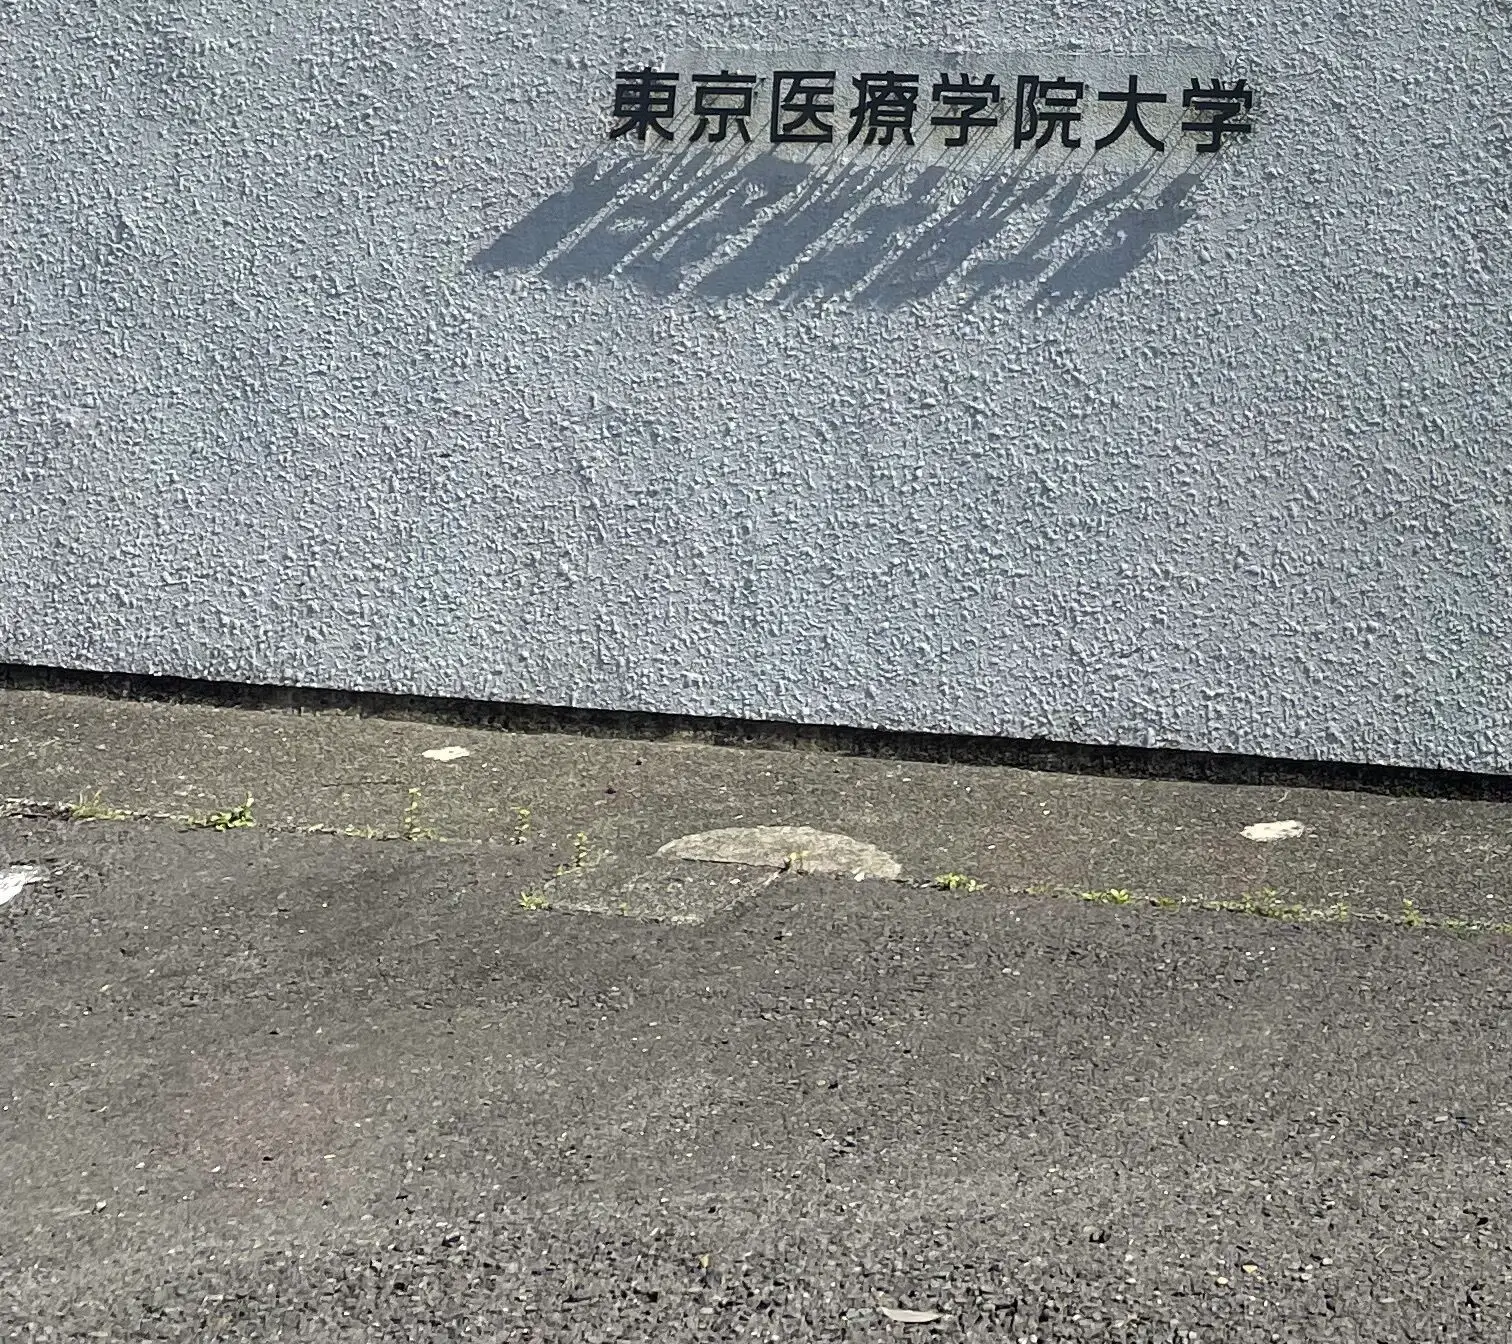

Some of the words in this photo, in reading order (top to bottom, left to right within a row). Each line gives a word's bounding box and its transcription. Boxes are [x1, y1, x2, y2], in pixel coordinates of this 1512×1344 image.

[608, 67, 1253, 153] 東京医療学院大学
